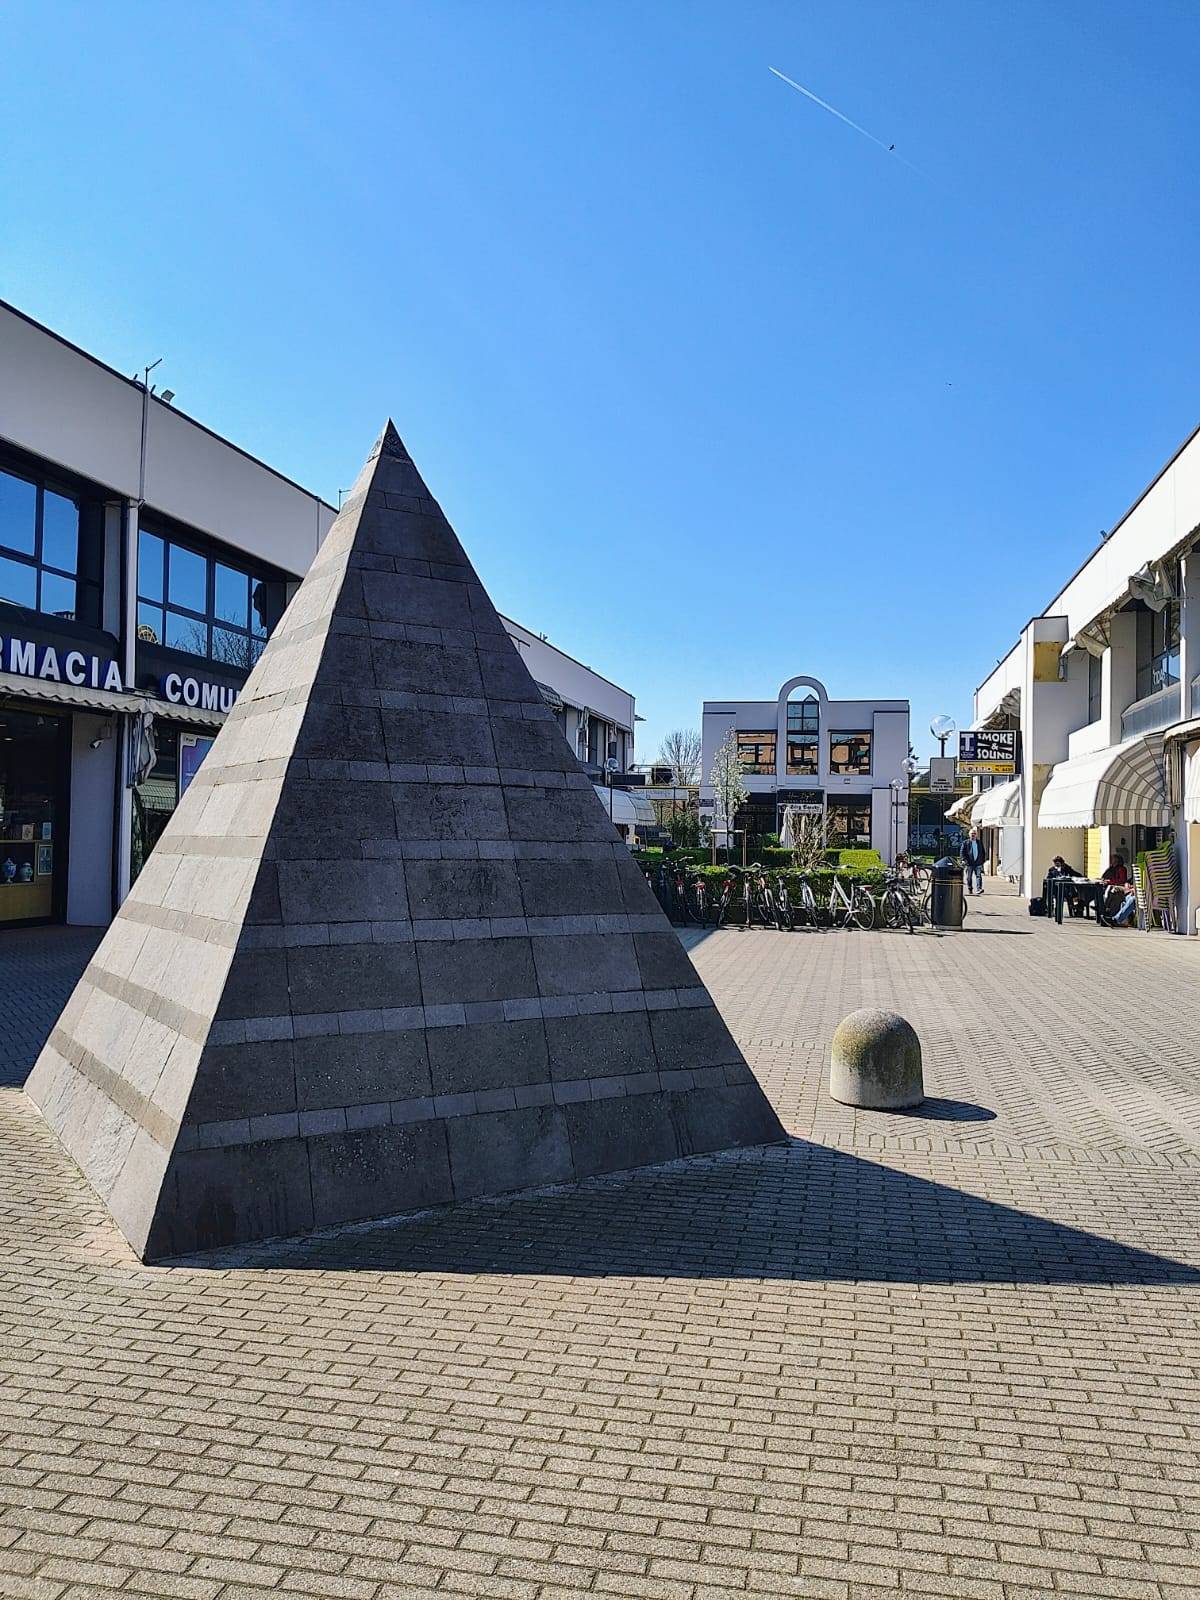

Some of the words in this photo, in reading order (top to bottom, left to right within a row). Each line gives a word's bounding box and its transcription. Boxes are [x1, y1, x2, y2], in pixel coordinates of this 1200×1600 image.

[0, 636, 123, 692] MACIA
[165, 673, 241, 714] COMU
[977, 733, 1013, 745] SMOKE
[977, 748, 1013, 760] SOUND
